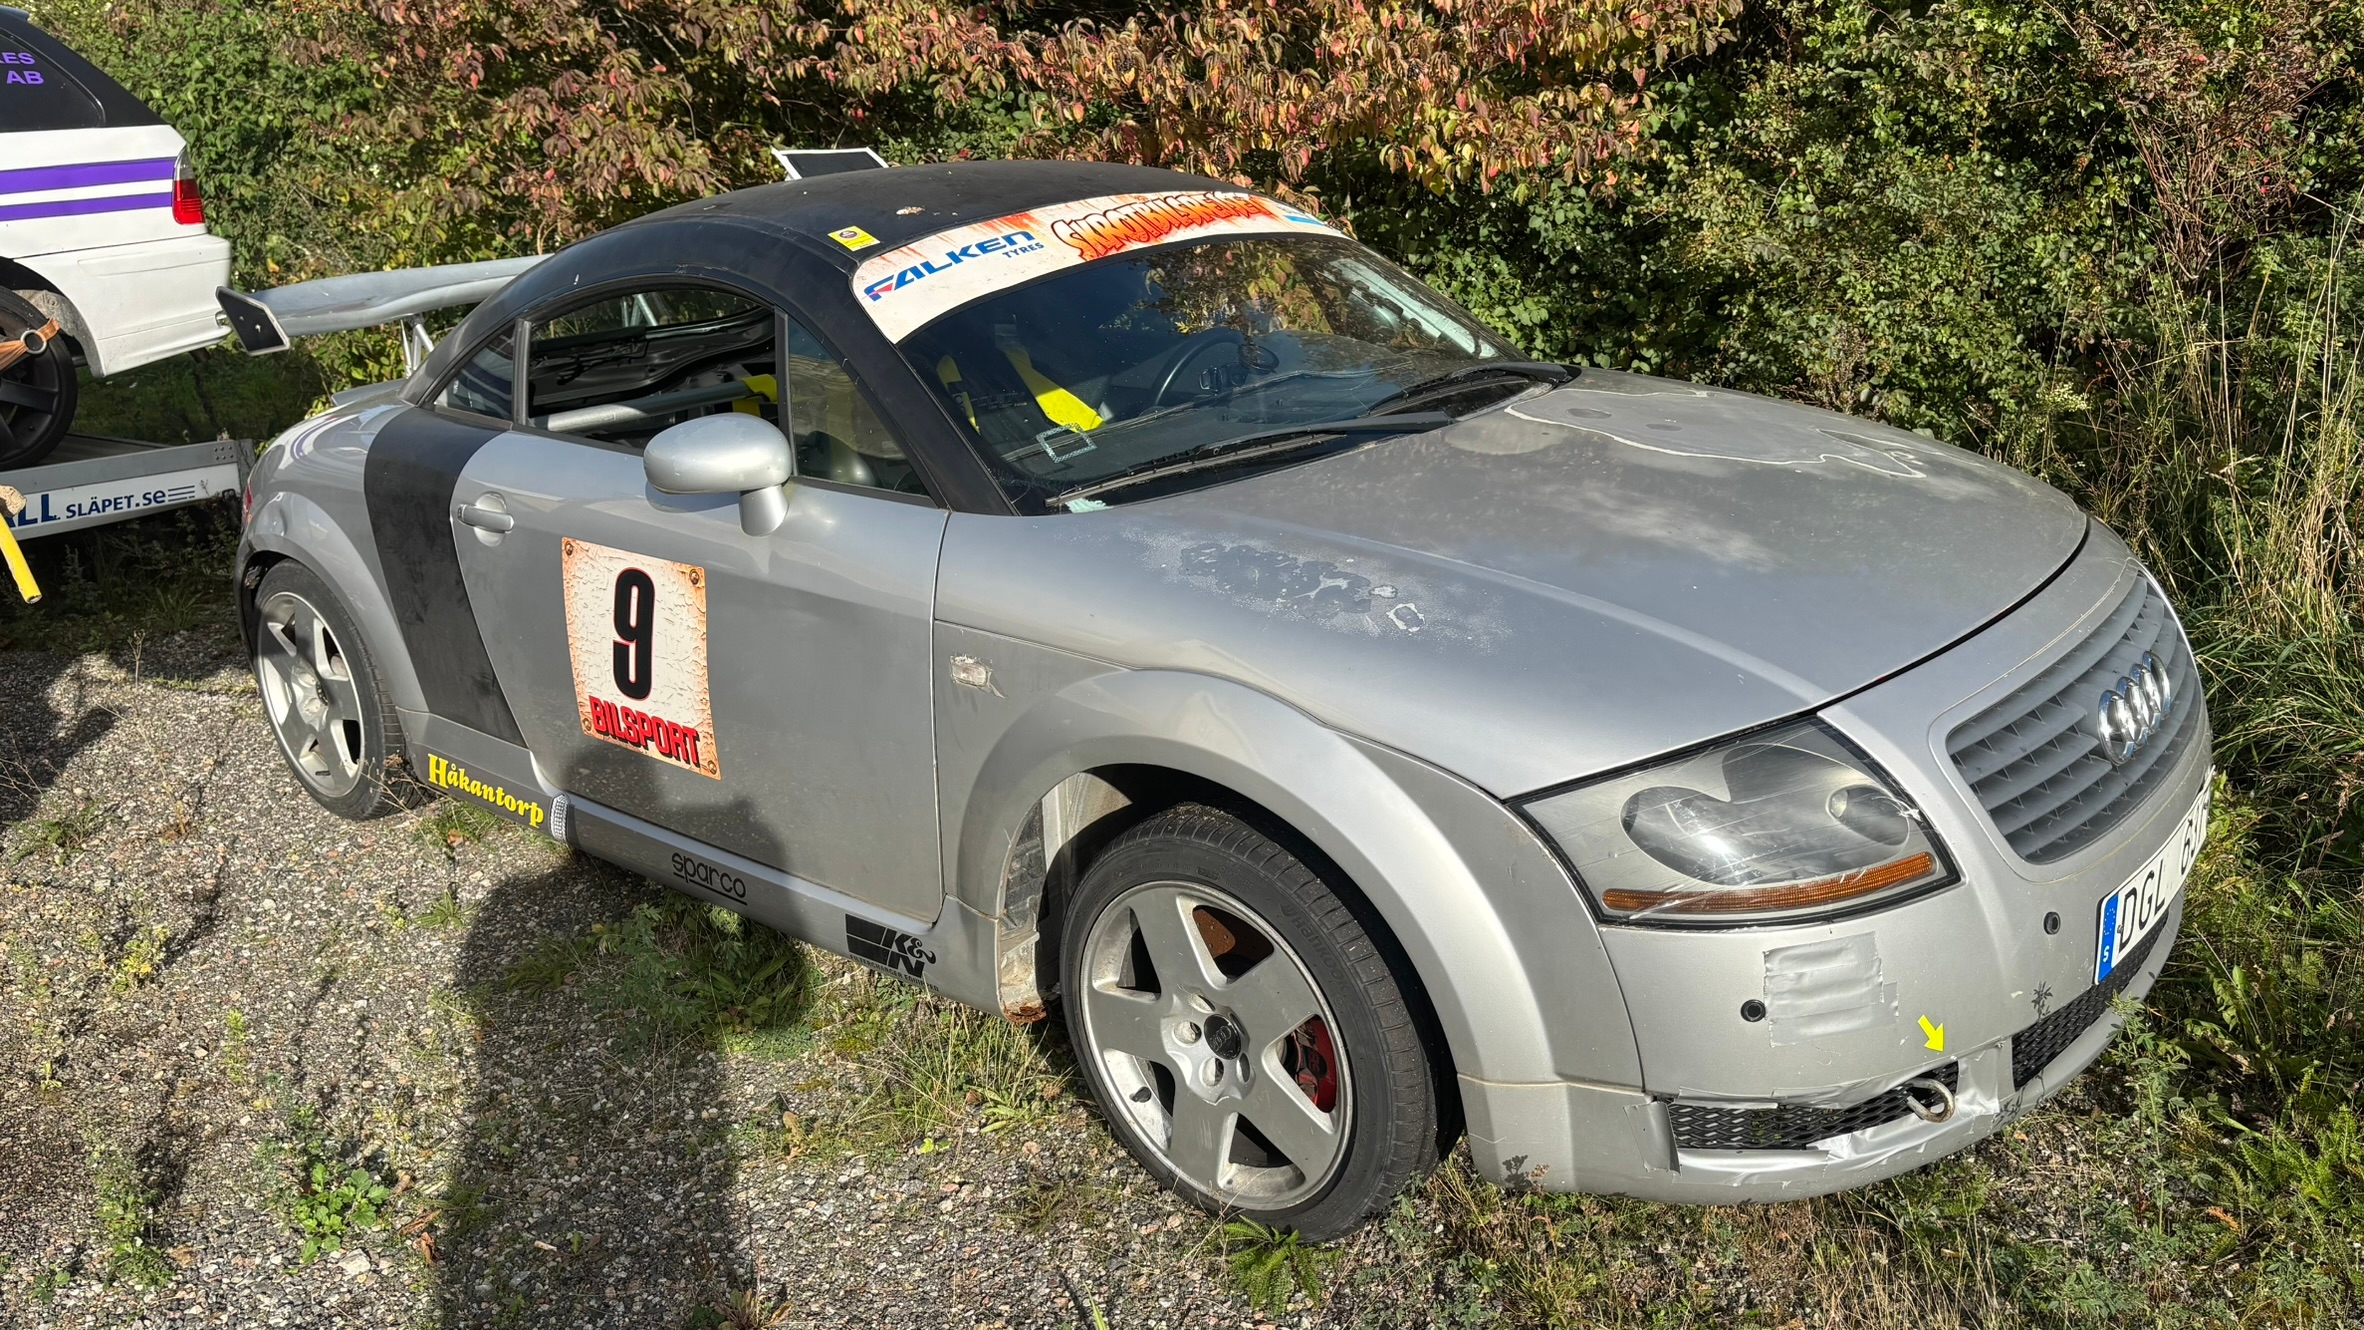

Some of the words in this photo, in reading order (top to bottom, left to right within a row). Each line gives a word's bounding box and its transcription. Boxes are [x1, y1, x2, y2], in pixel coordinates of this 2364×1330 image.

[0, 52, 35, 64] ES
[6, 70, 44, 84] AB
[863, 230, 1036, 302] FALKEN
[1002, 242, 1045, 259] TYRES
[613, 566, 656, 701] 9
[589, 695, 701, 768] BILSPORT
[427, 753, 545, 829] Håkantorp
[671, 852, 747, 899] sparco
[2118, 859, 2166, 954] DGL
[2103, 945, 2110, 962] S
